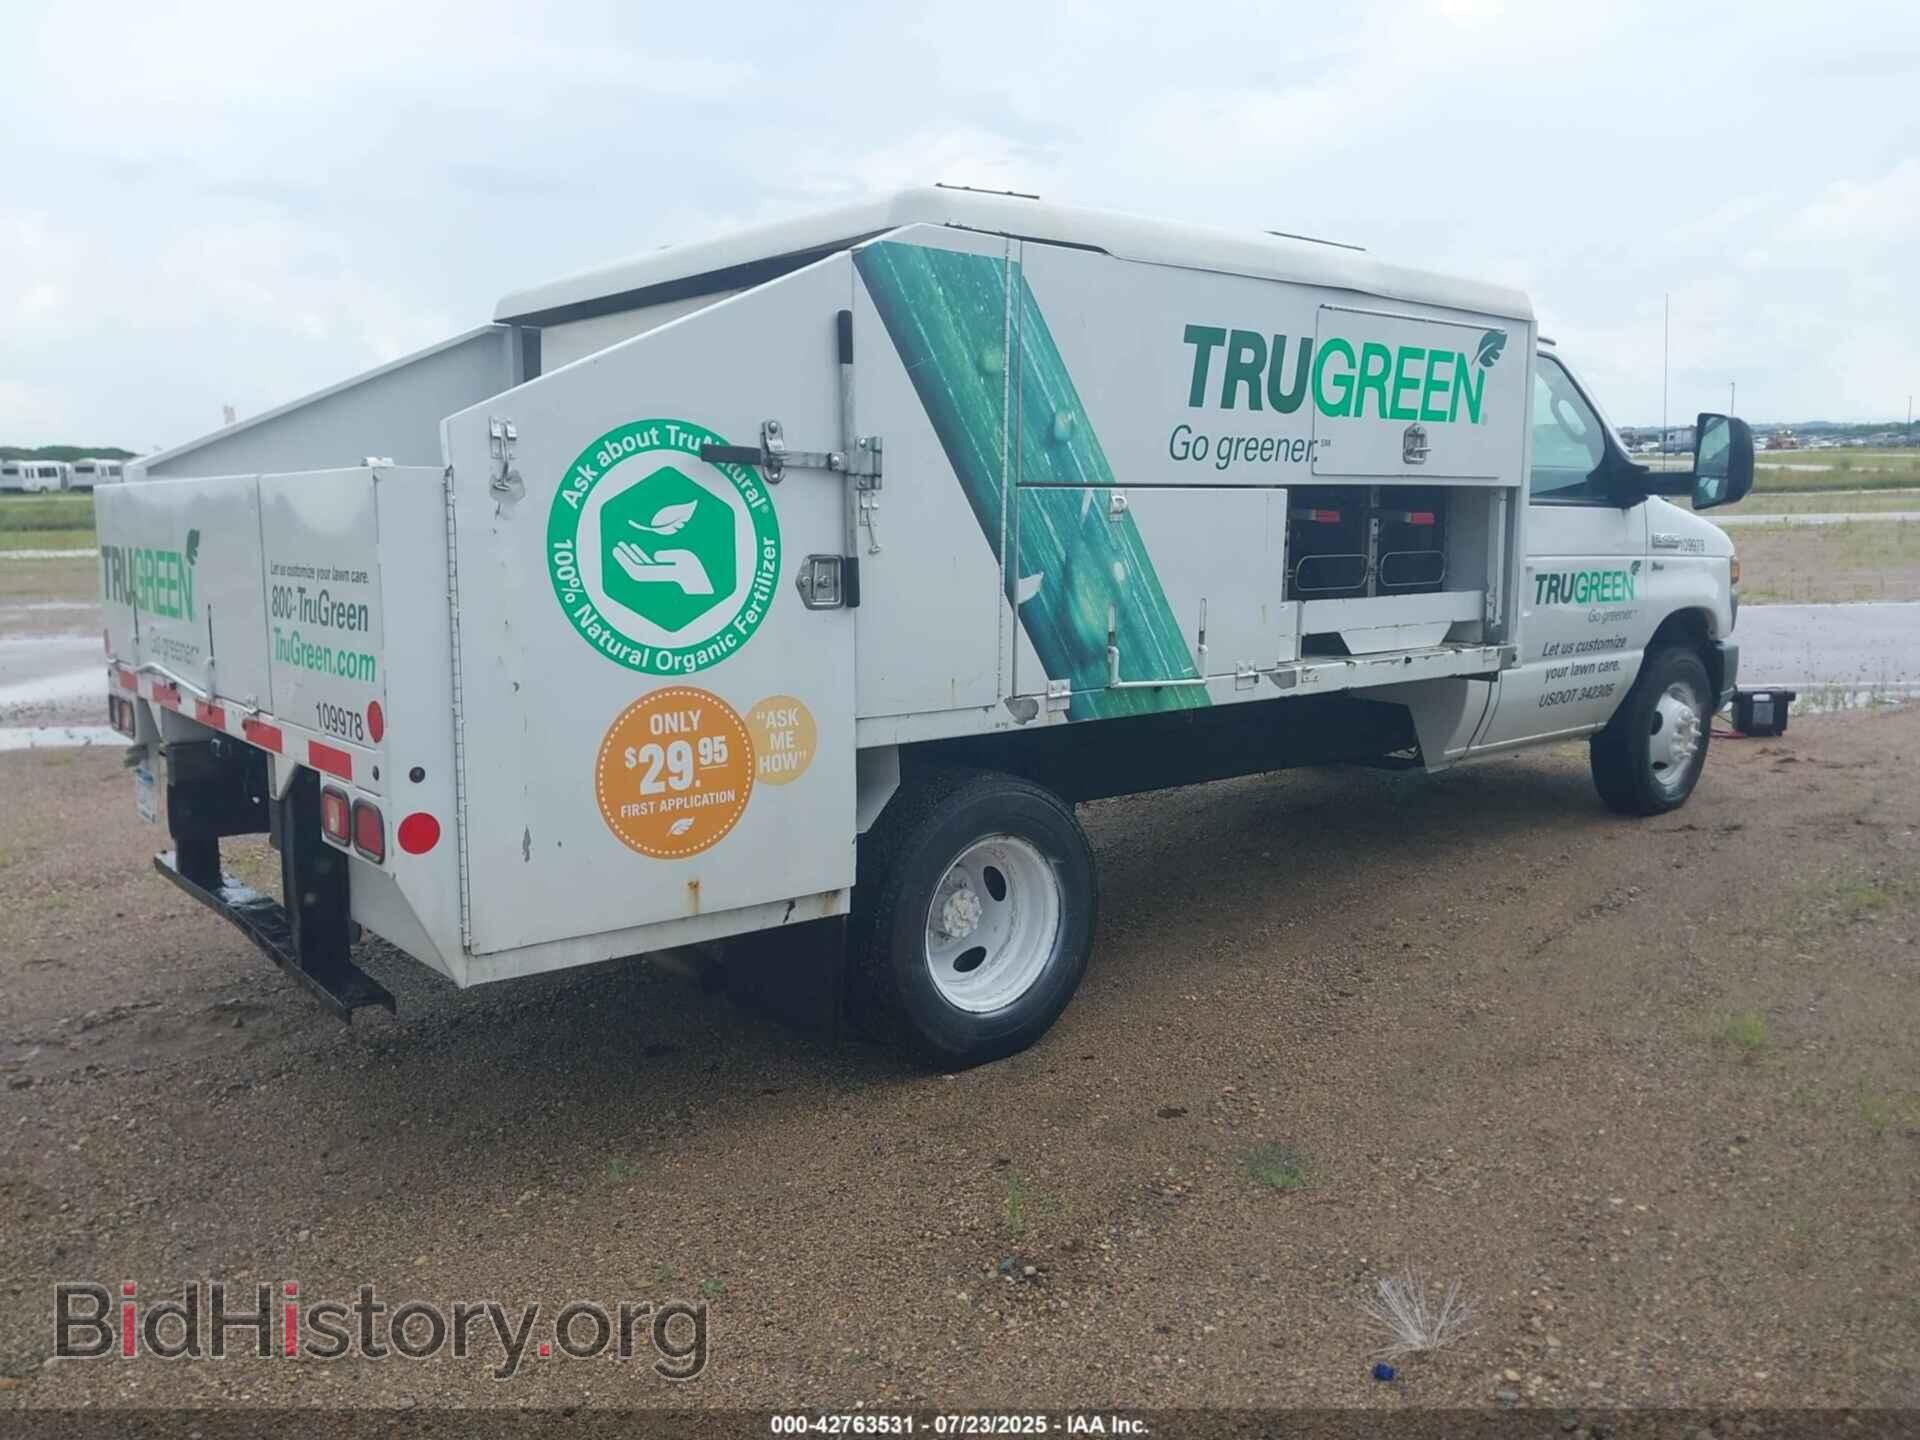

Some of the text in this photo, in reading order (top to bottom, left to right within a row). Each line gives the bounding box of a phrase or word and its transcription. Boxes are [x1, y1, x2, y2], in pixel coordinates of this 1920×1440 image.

[1183, 323, 1486, 425] TRUGREEN
[1169, 424, 1209, 462] Go
[1216, 436, 1318, 470] greener.
[562, 464, 598, 510] Ask
[596, 427, 660, 467] about
[102, 545, 193, 623] TRUGREEN
[351, 570, 369, 584] care.
[1535, 571, 1635, 605] TRUGREEN
[271, 584, 369, 632] 800-TruGreen
[553, 536, 776, 674] 100% Natural Organic Fertilizer
[273, 626, 376, 683] TruGreen.com
[1542, 634, 1627, 657] Let us customize
[1545, 660, 1621, 684] your lawn care.
[1539, 687, 1580, 708] USDOT
[316, 701, 365, 742] 109978
[649, 709, 702, 736] ONLY
[769, 730, 796, 751] ME
[620, 789, 737, 818] FIRST APPLICATION
